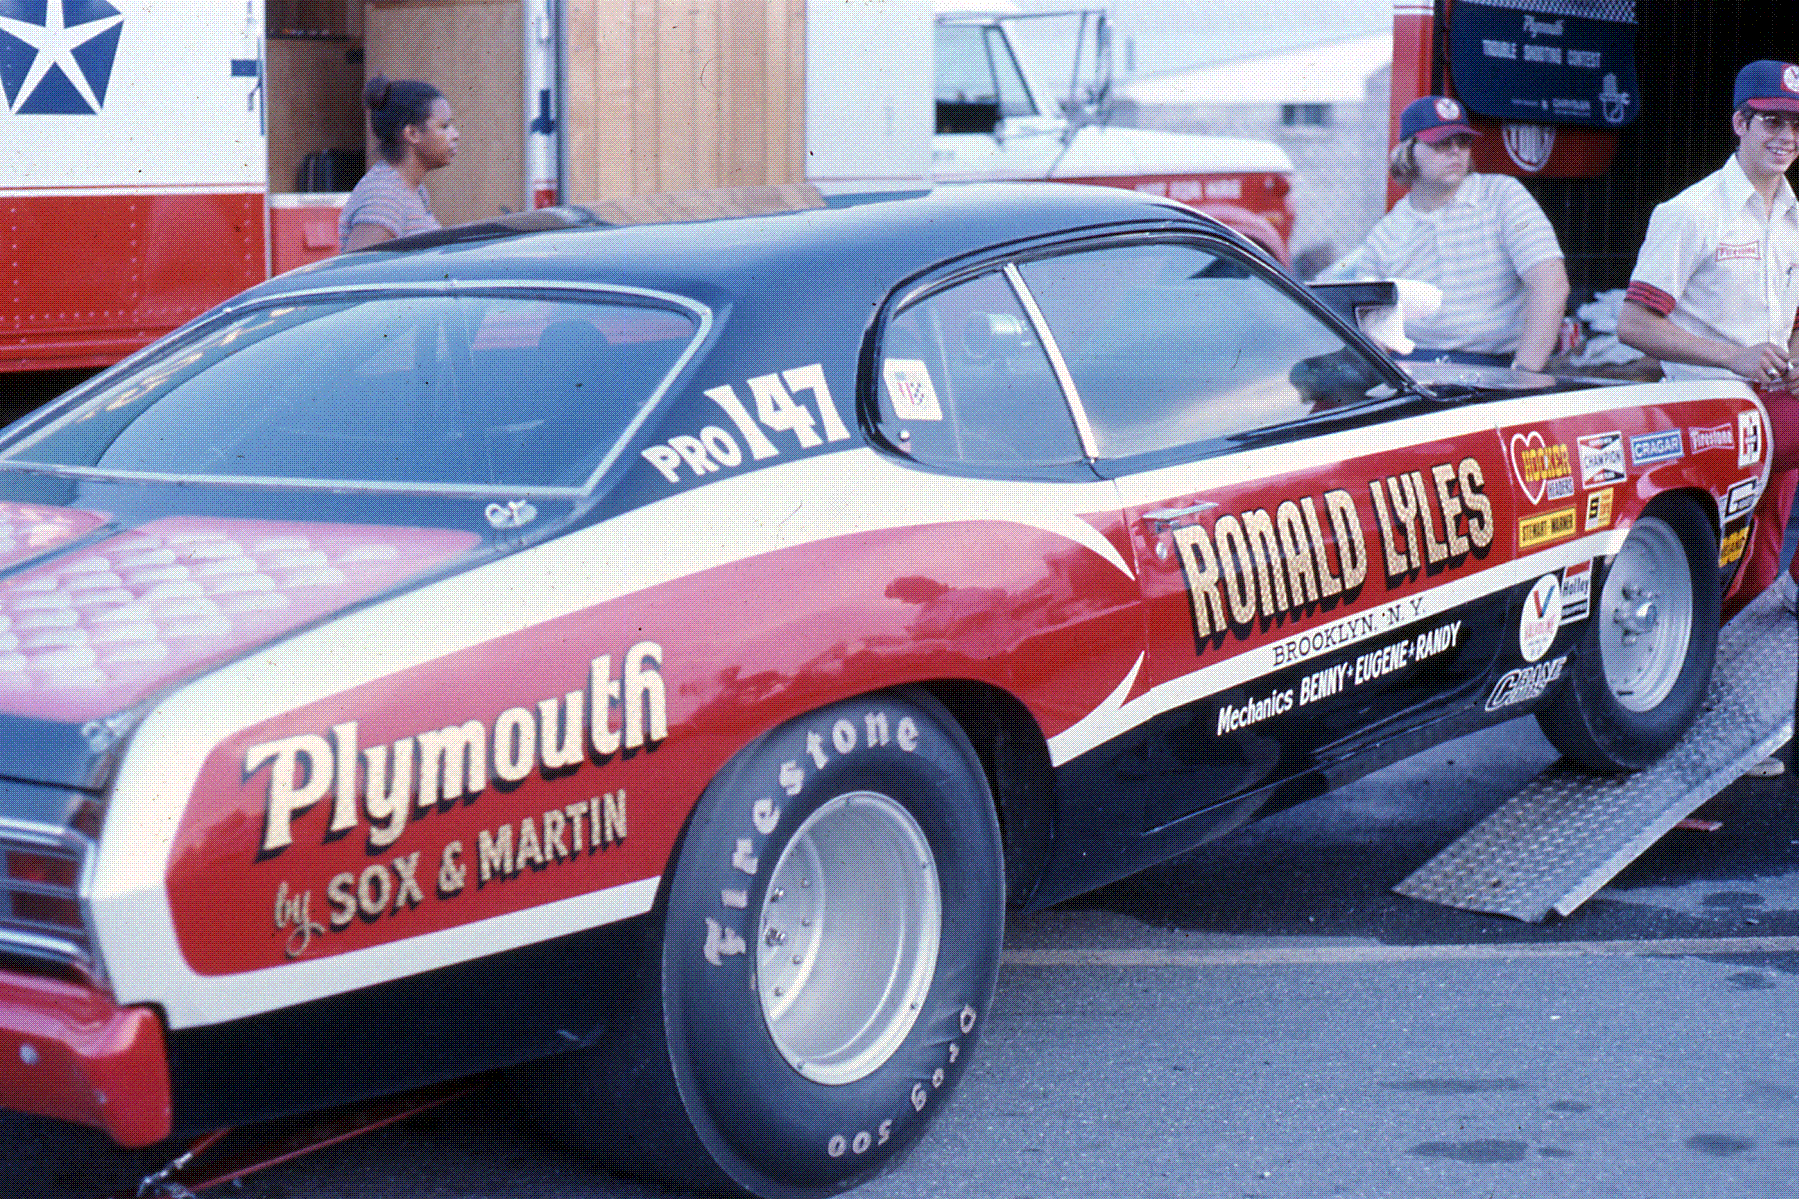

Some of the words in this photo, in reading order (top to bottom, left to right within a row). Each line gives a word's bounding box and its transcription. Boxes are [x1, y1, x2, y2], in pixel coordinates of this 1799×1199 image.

[641, 426, 742, 482] PRO
[704, 363, 850, 460] 147
[1583, 450, 1621, 469] CHAMPION
[1634, 436, 1681, 459] CRAGAR
[1689, 428, 1734, 450] Firestone
[1521, 443, 1572, 483] HOOKER
[1172, 487, 1368, 640] RONALD
[1369, 457, 1494, 577] LYLES
[1562, 577, 1589, 598] Holley
[1217, 688, 1293, 736] Mechanics
[1300, 662, 1348, 706] BENNY
[1354, 639, 1409, 686] EUGENE
[1415, 619, 1462, 662] RANDY
[244, 641, 669, 852] Plymouth
[274, 880, 325, 957] by
[327, 851, 424, 926] SOX
[438, 841, 467, 893] &
[478, 788, 628, 881] MARTIN
[703, 710, 920, 967] Firestone
[827, 1118, 893, 1158] 500
